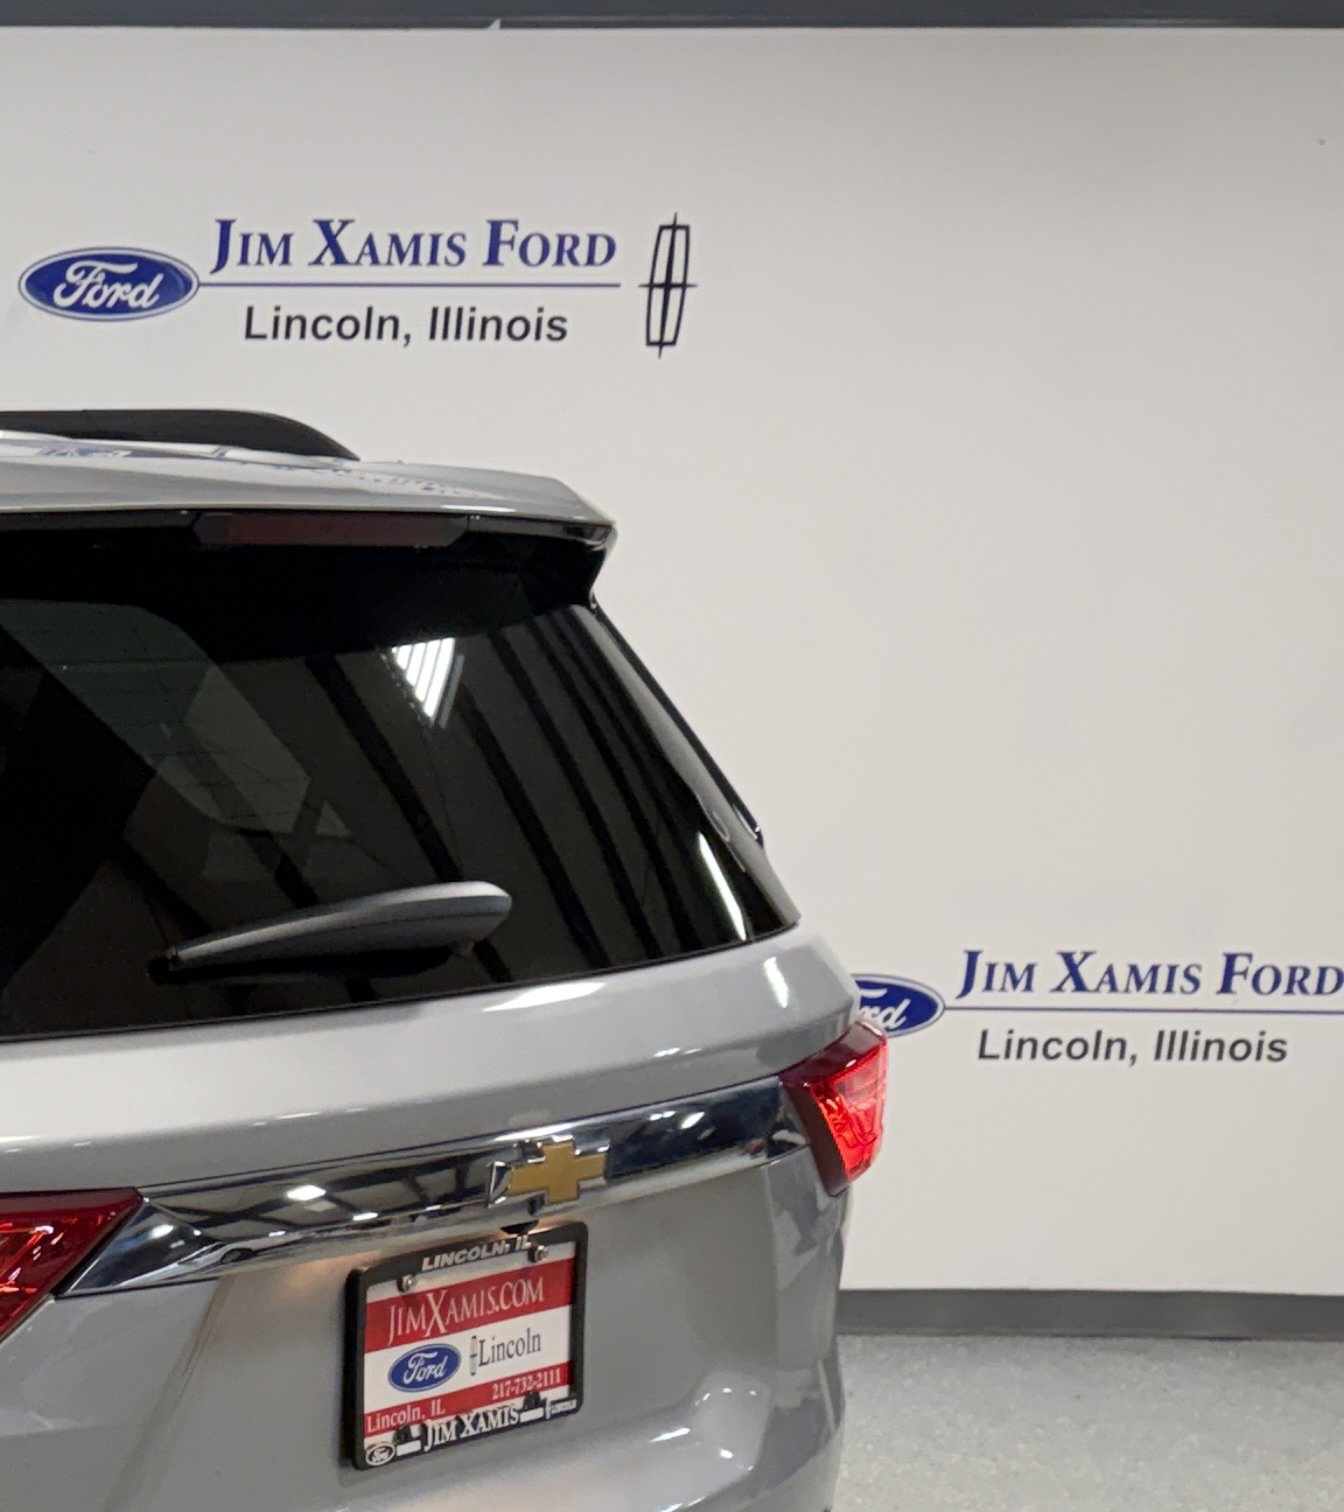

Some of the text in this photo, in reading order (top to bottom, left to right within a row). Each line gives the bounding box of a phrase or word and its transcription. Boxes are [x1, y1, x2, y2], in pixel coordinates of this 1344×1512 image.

[209, 218, 617, 275] JIM XAMIS FORD
[53, 261, 160, 309] Ford
[244, 305, 568, 348] Lincoln, Illinois
[954, 950, 1344, 1000] JIM XAMIS FORD
[978, 1029, 1288, 1066] Lincoln, Illinois
[403, 1351, 448, 1385] Ford
[478, 1327, 542, 1367] Lincoln
[424, 1418, 457, 1452] JIM
[460, 1405, 521, 1438] XAMIS
[430, 1399, 446, 1417] IL
